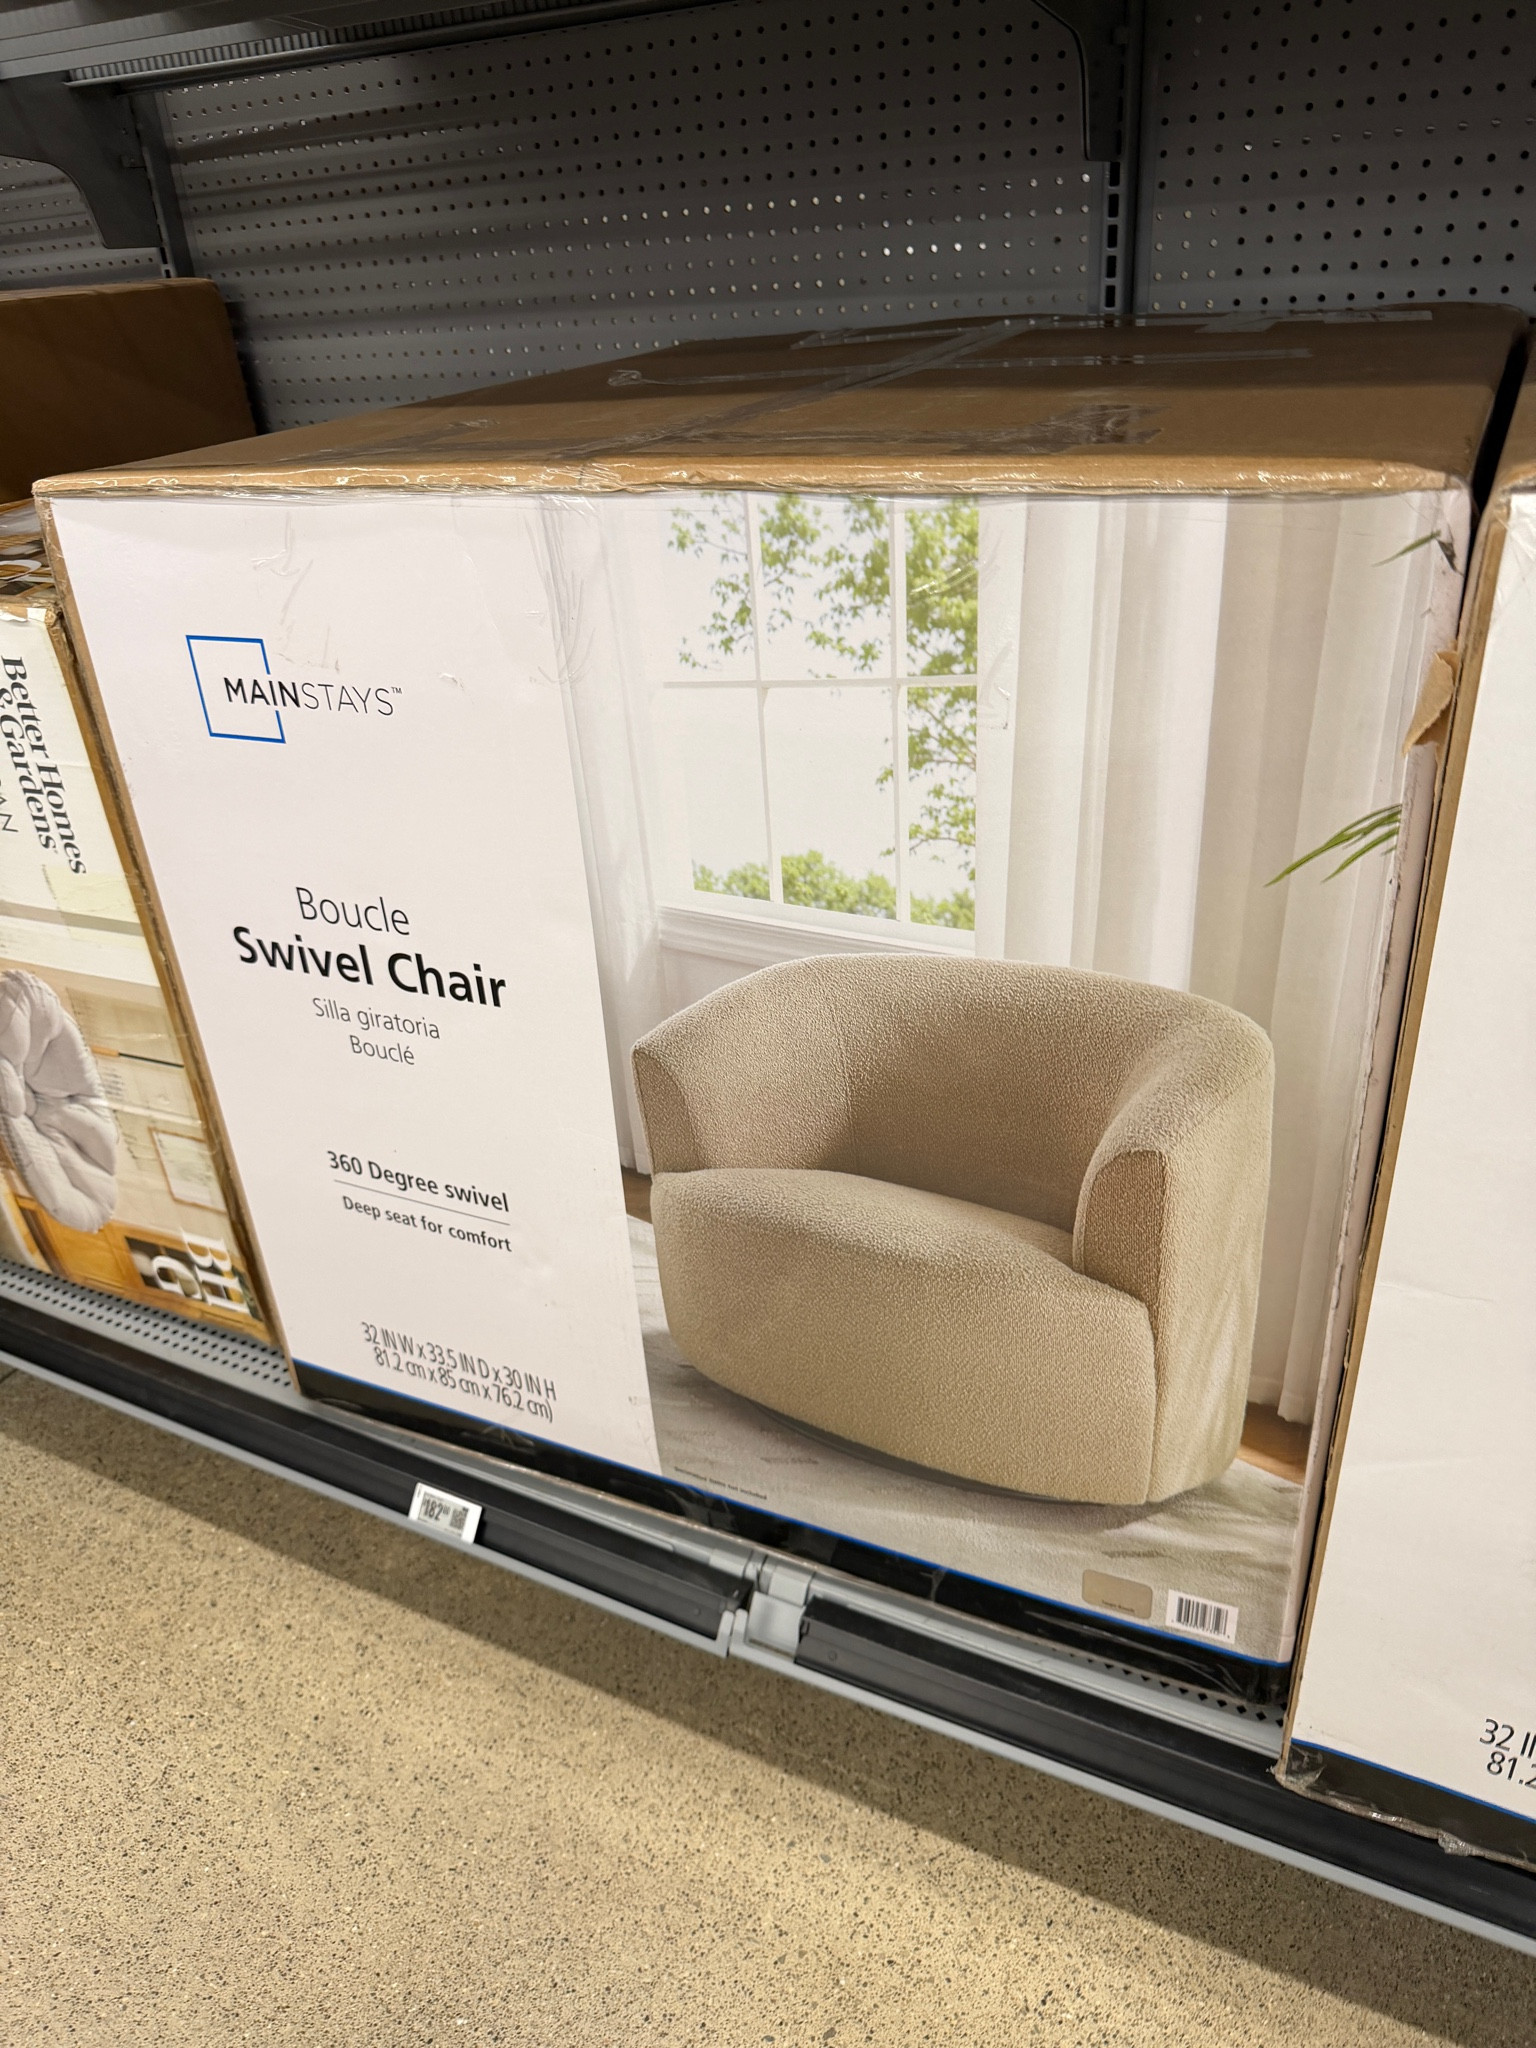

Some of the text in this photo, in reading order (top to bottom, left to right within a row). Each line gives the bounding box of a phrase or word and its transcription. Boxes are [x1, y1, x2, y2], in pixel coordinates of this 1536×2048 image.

[1, 655, 87, 875] Better Homes
[295, 886, 410, 936] Boucle
[233, 926, 506, 1008] Swivel Chair
[312, 997, 441, 1039] Silla giratoria
[349, 1034, 415, 1065] Bouclé
[327, 1150, 509, 1212] 360 Degree swivel
[342, 1195, 512, 1252] Deep seat for comfort
[361, 1321, 557, 1401] 32 IN W x 33.5 IN D x 30 IN H
[374, 1346, 554, 1423] 81.2 cm x 85 cm x 76.2 cm)
[1479, 1718, 1515, 1752] 32
